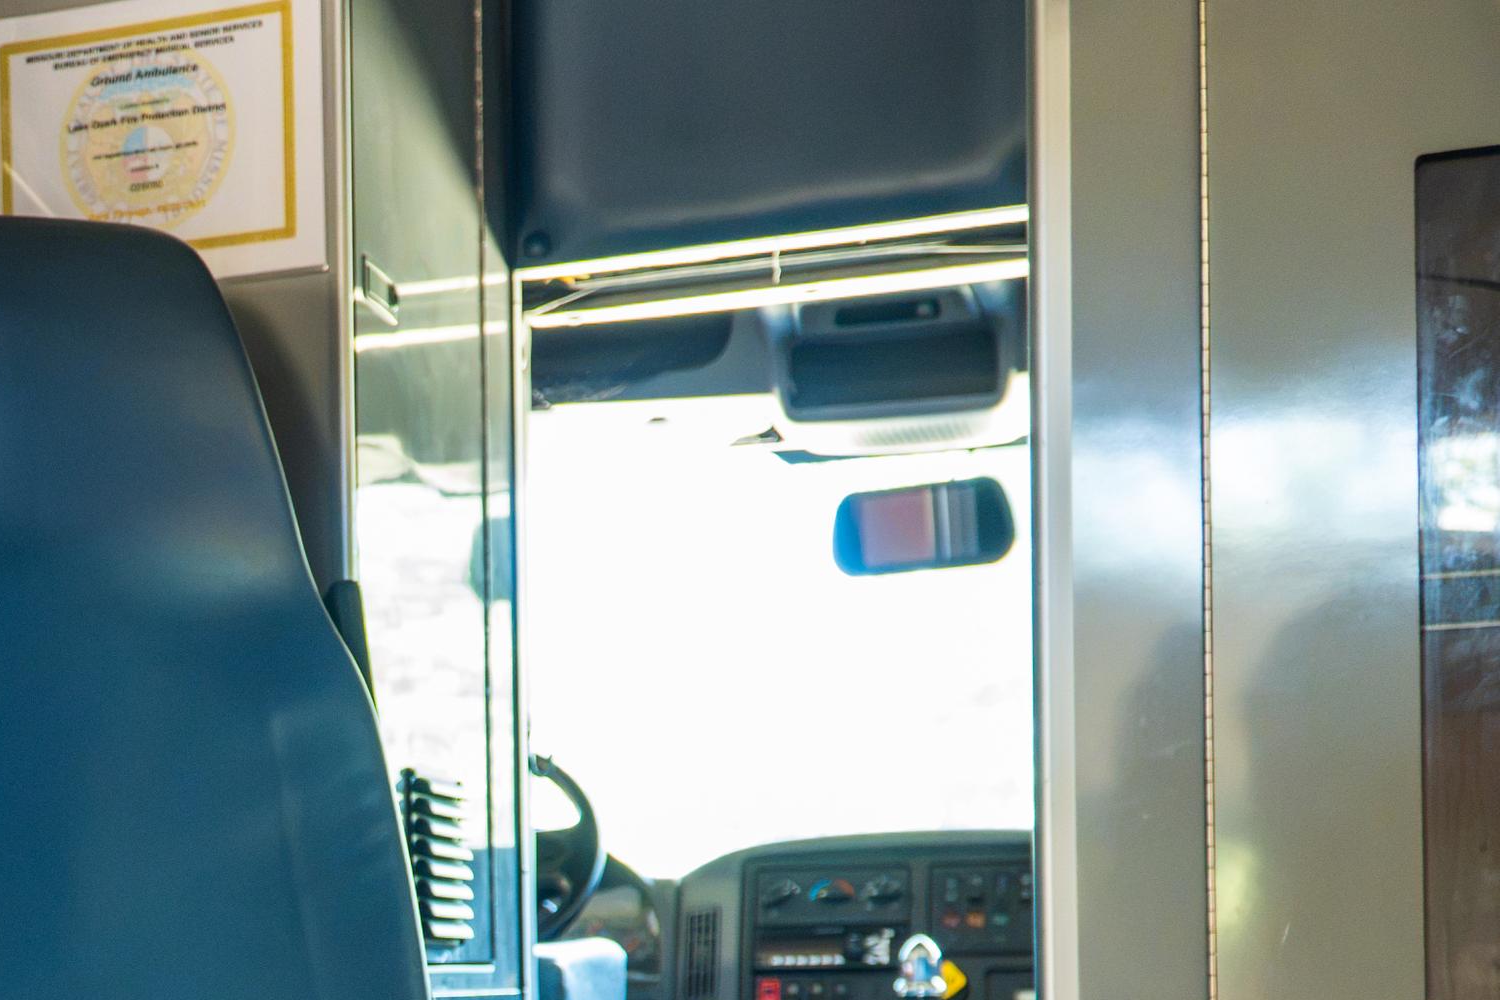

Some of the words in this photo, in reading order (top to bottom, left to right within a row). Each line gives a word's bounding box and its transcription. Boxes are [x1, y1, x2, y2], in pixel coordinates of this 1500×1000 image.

[53, 59, 86, 71] BUREAU
[155, 42, 190, 54] MEDICAL
[194, 35, 235, 48] SERVICES
[66, 43, 121, 57] DEPARTMENT
[136, 35, 167, 47] HEALTH
[170, 31, 187, 42] AND
[189, 27, 220, 39] SENIOR
[222, 20, 263, 33] SERVICES
[91, 71, 133, 87] Ground
[135, 63, 198, 81] Ambulance
[68, 121, 89, 133] Lake
[120, 114, 138, 125] Fire
[141, 107, 189, 121] Protection
[192, 102, 227, 115] District
